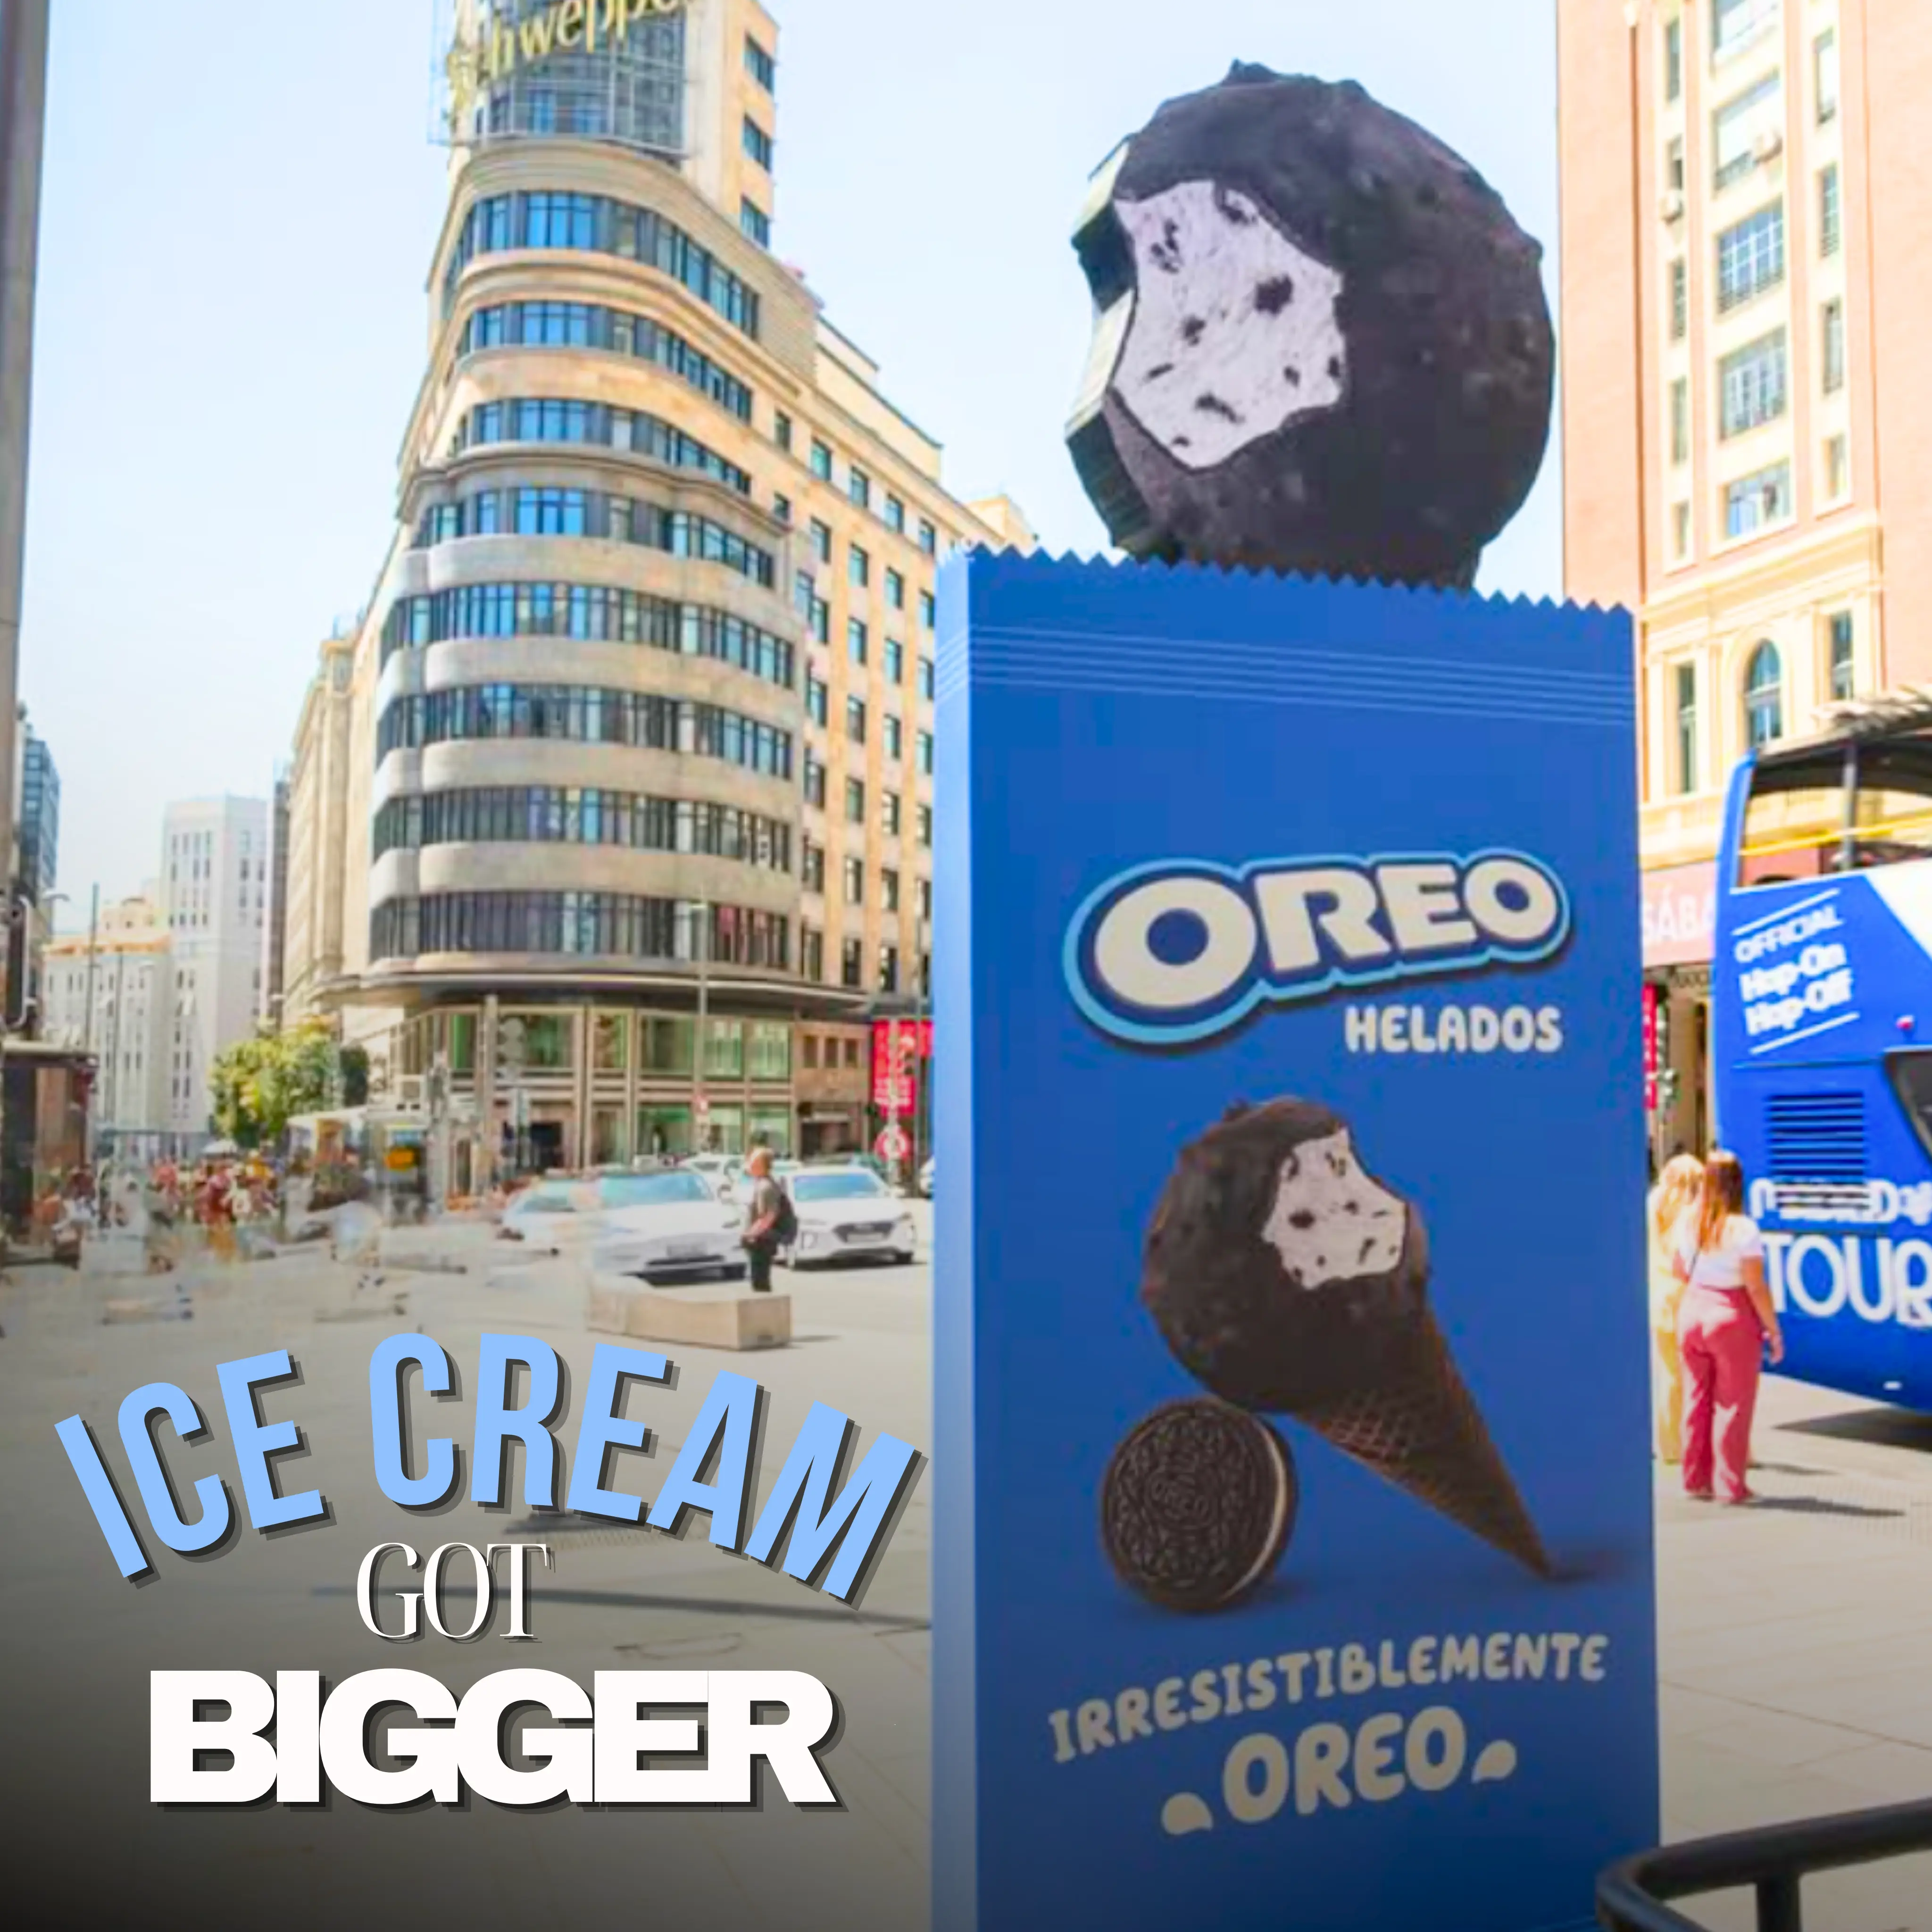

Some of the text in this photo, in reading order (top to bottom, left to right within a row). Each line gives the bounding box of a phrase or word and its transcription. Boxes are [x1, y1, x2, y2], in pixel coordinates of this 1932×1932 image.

[1094, 859, 1557, 1007] OREO
[1734, 905, 1844, 963] OFFICIAL
[1740, 943, 1847, 1001] Hop-On
[1745, 967, 1852, 1035] Hop-Off
[1345, 1005, 1563, 1054] HELADOS
[1048, 1632, 1609, 1763] IRRESISTIBLEMENTE
[1222, 1705, 1467, 1824] OREO
